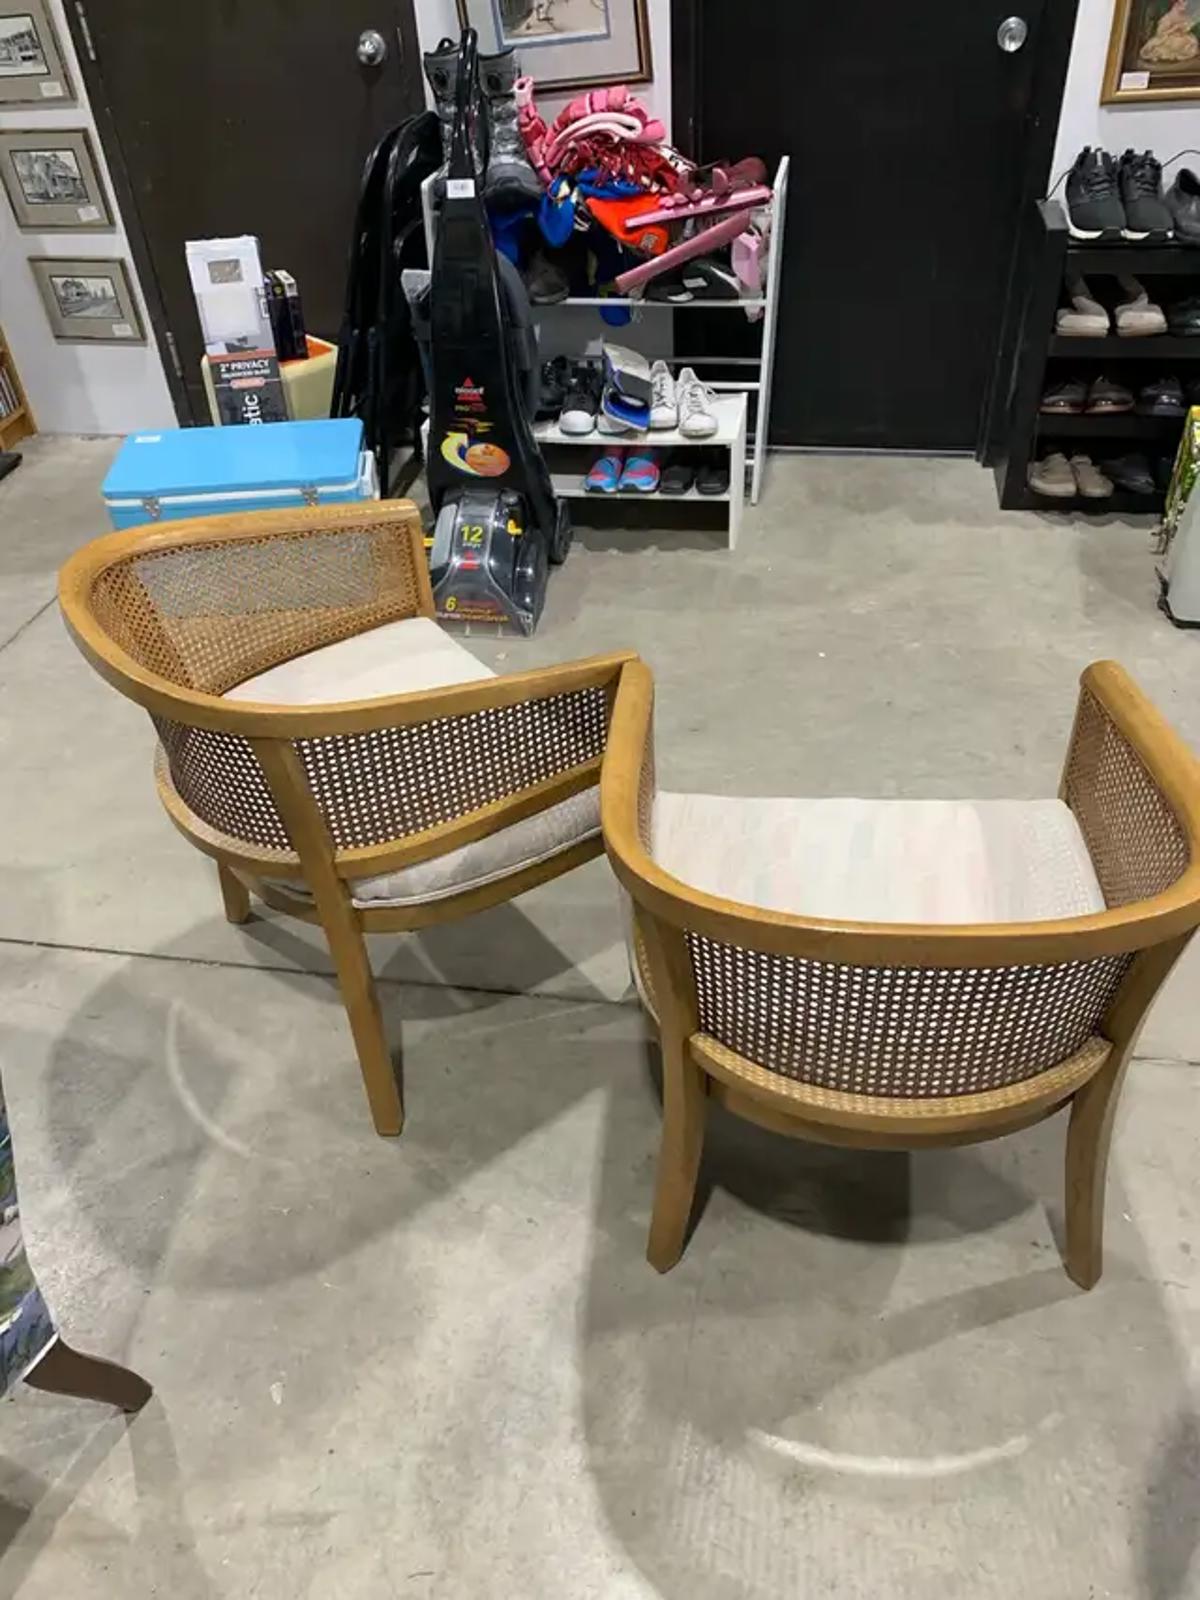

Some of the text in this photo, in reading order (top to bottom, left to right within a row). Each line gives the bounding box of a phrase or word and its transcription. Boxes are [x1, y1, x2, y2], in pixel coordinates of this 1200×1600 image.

[230, 359, 270, 371] PRIVACY
[461, 524, 484, 544] 12
[445, 595, 458, 612] 6
